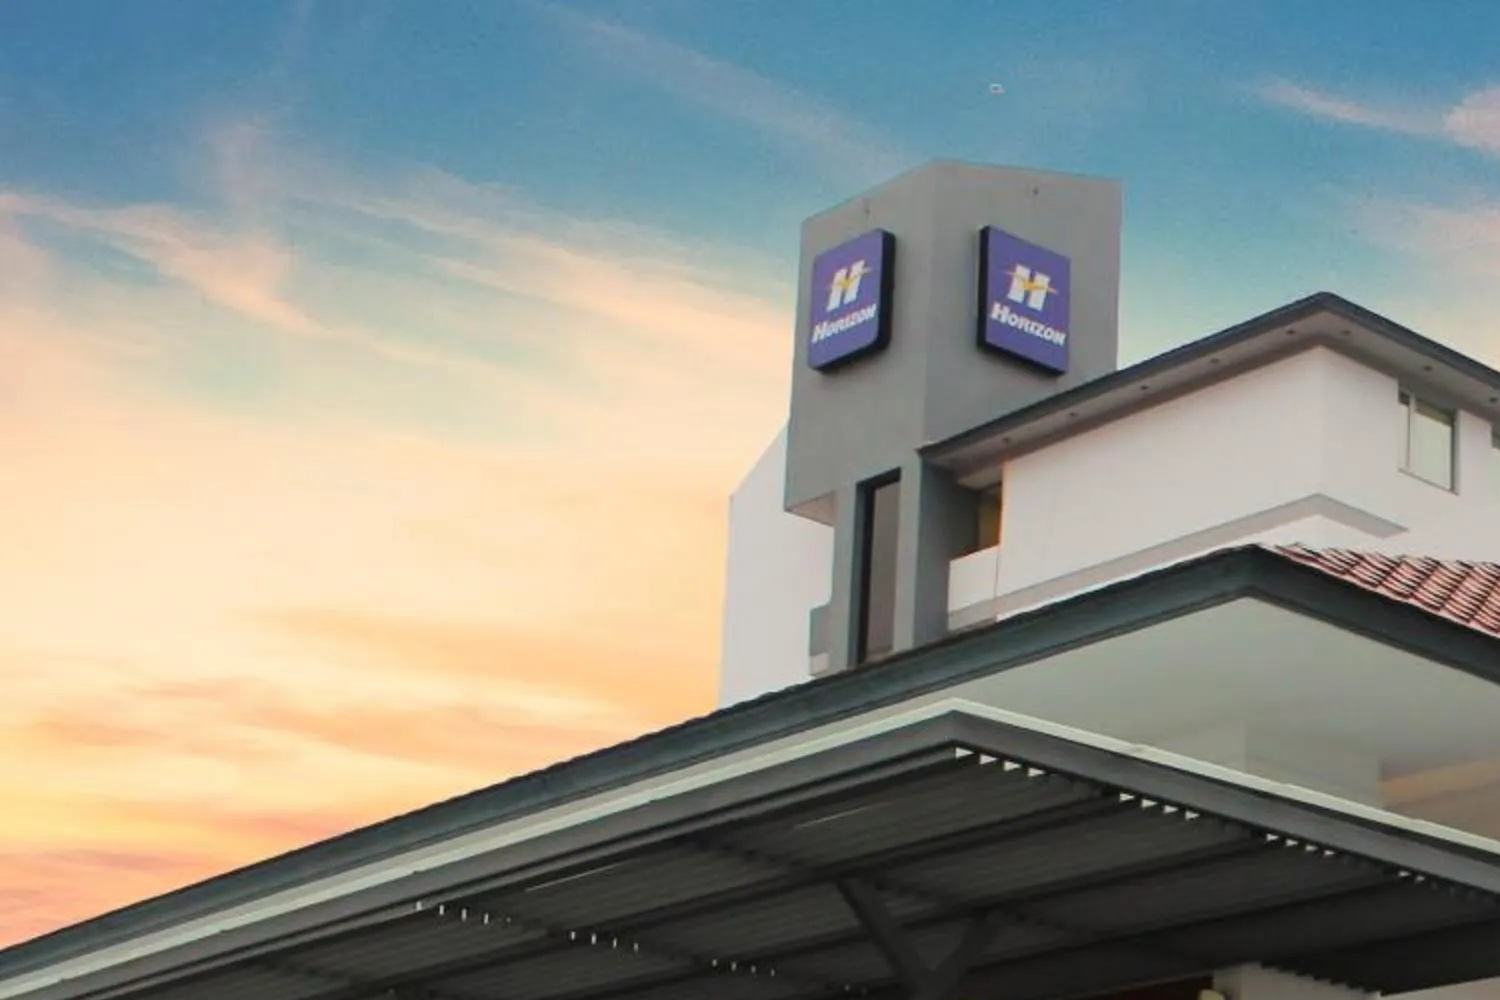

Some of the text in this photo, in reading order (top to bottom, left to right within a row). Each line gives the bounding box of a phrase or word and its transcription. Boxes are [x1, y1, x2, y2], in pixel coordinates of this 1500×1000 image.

[827, 260, 866, 311] H
[1008, 264, 1050, 311] H
[813, 304, 876, 343] HORIZON
[991, 303, 1066, 345] HORIZON
